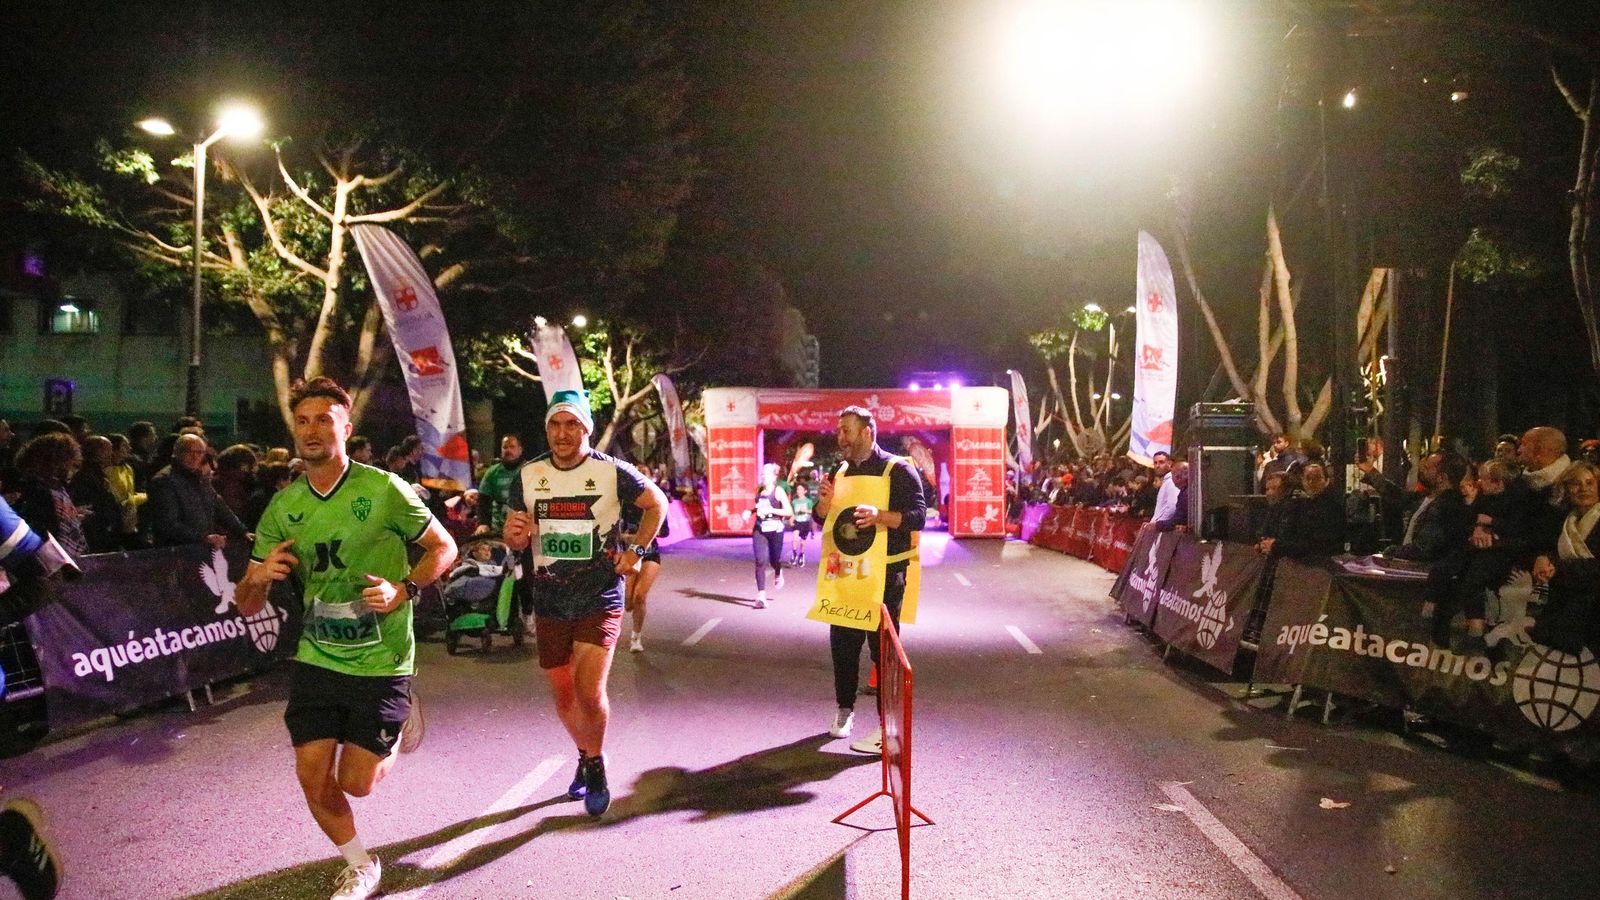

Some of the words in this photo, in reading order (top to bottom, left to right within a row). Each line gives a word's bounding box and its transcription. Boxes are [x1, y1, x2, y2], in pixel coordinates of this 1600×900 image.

[538, 502, 548, 512] 58
[548, 540, 581, 554] 606
[819, 598, 872, 622] RECICLA
[318, 621, 373, 641] 1302
[71, 615, 247, 682] aquéatacamos
[1276, 614, 1511, 686] aquéatacamos
